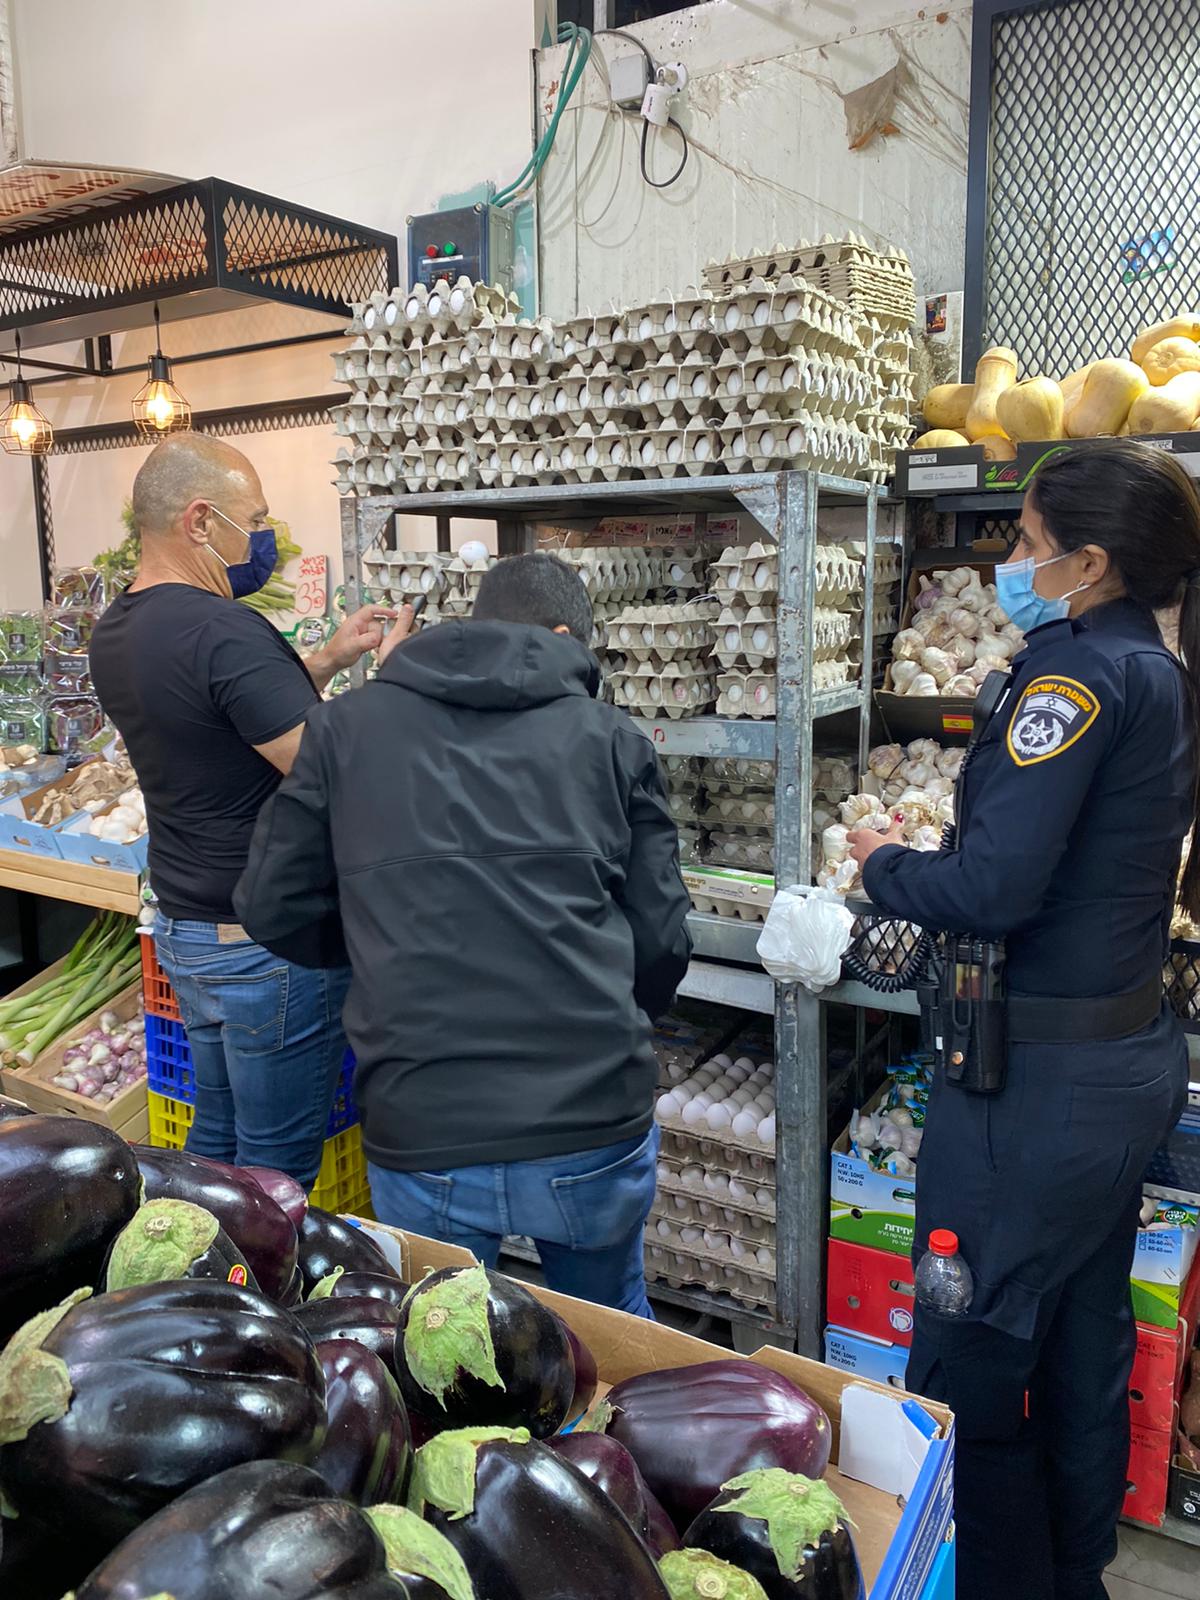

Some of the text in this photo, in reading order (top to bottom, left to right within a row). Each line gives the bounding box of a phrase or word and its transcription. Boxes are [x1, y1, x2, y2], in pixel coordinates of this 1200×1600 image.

[1025, 683, 1093, 712] משטרת ישראל
[884, 1223, 913, 1236] יחידות
